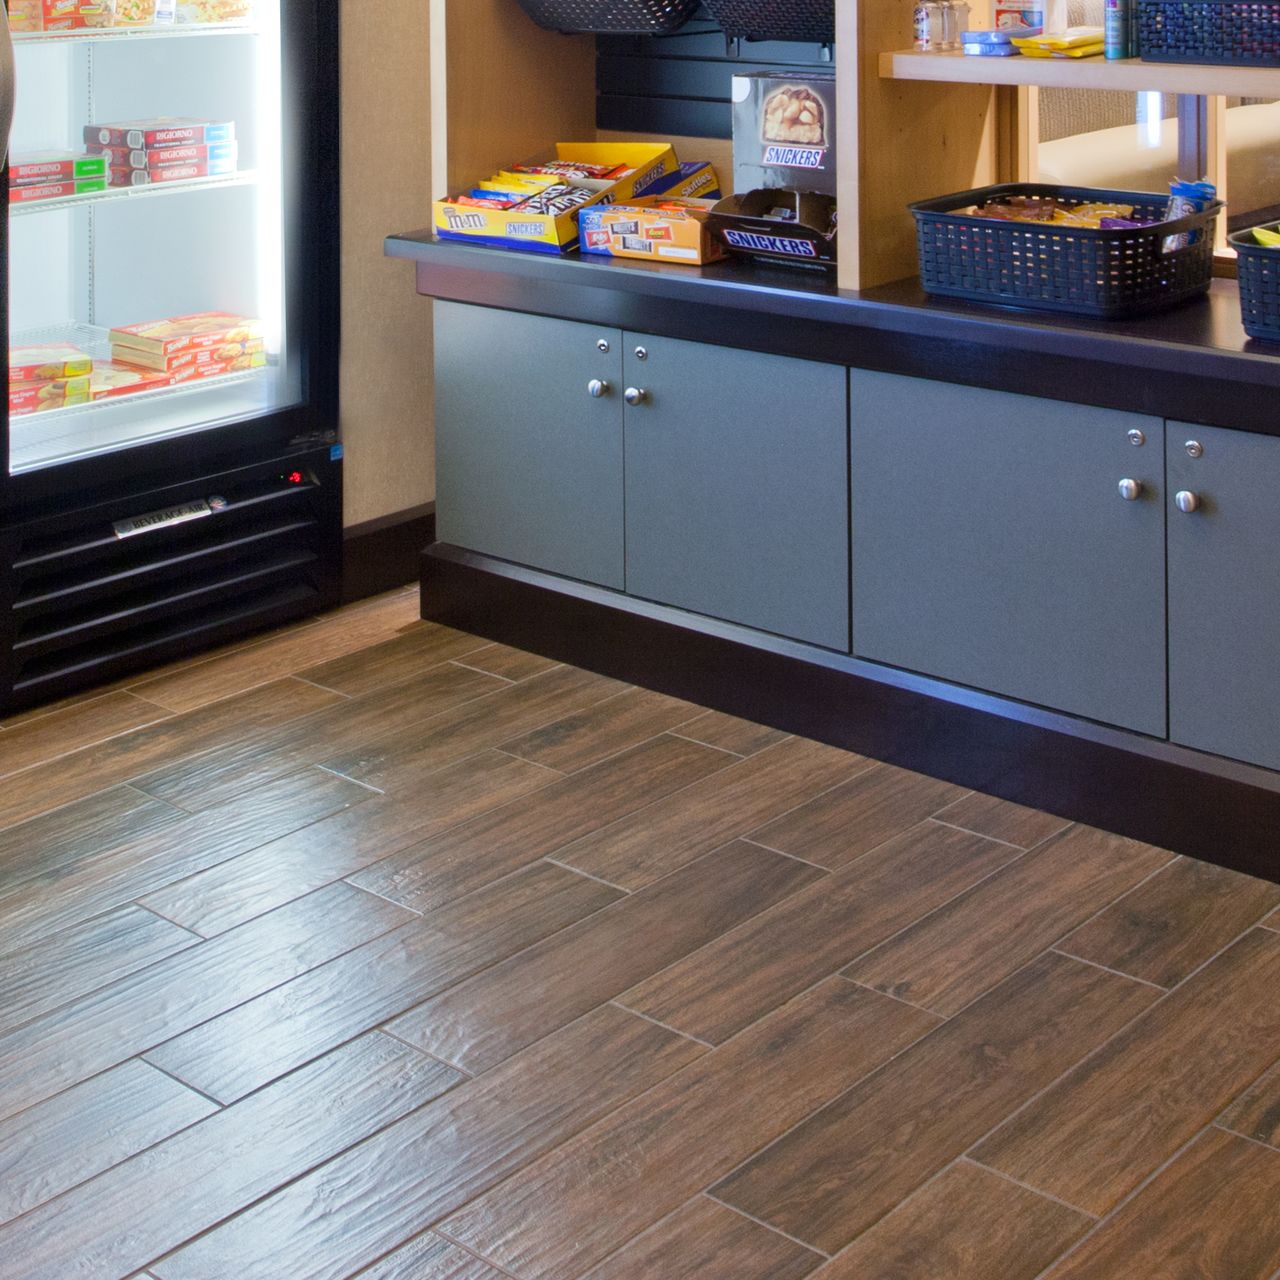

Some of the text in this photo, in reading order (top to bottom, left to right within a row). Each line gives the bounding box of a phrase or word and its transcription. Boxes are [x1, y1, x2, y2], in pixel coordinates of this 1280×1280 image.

[766, 147, 820, 167] SNICKERS
[507, 223, 544, 236] SNICKERS
[726, 230, 815, 256] SNICKERS
